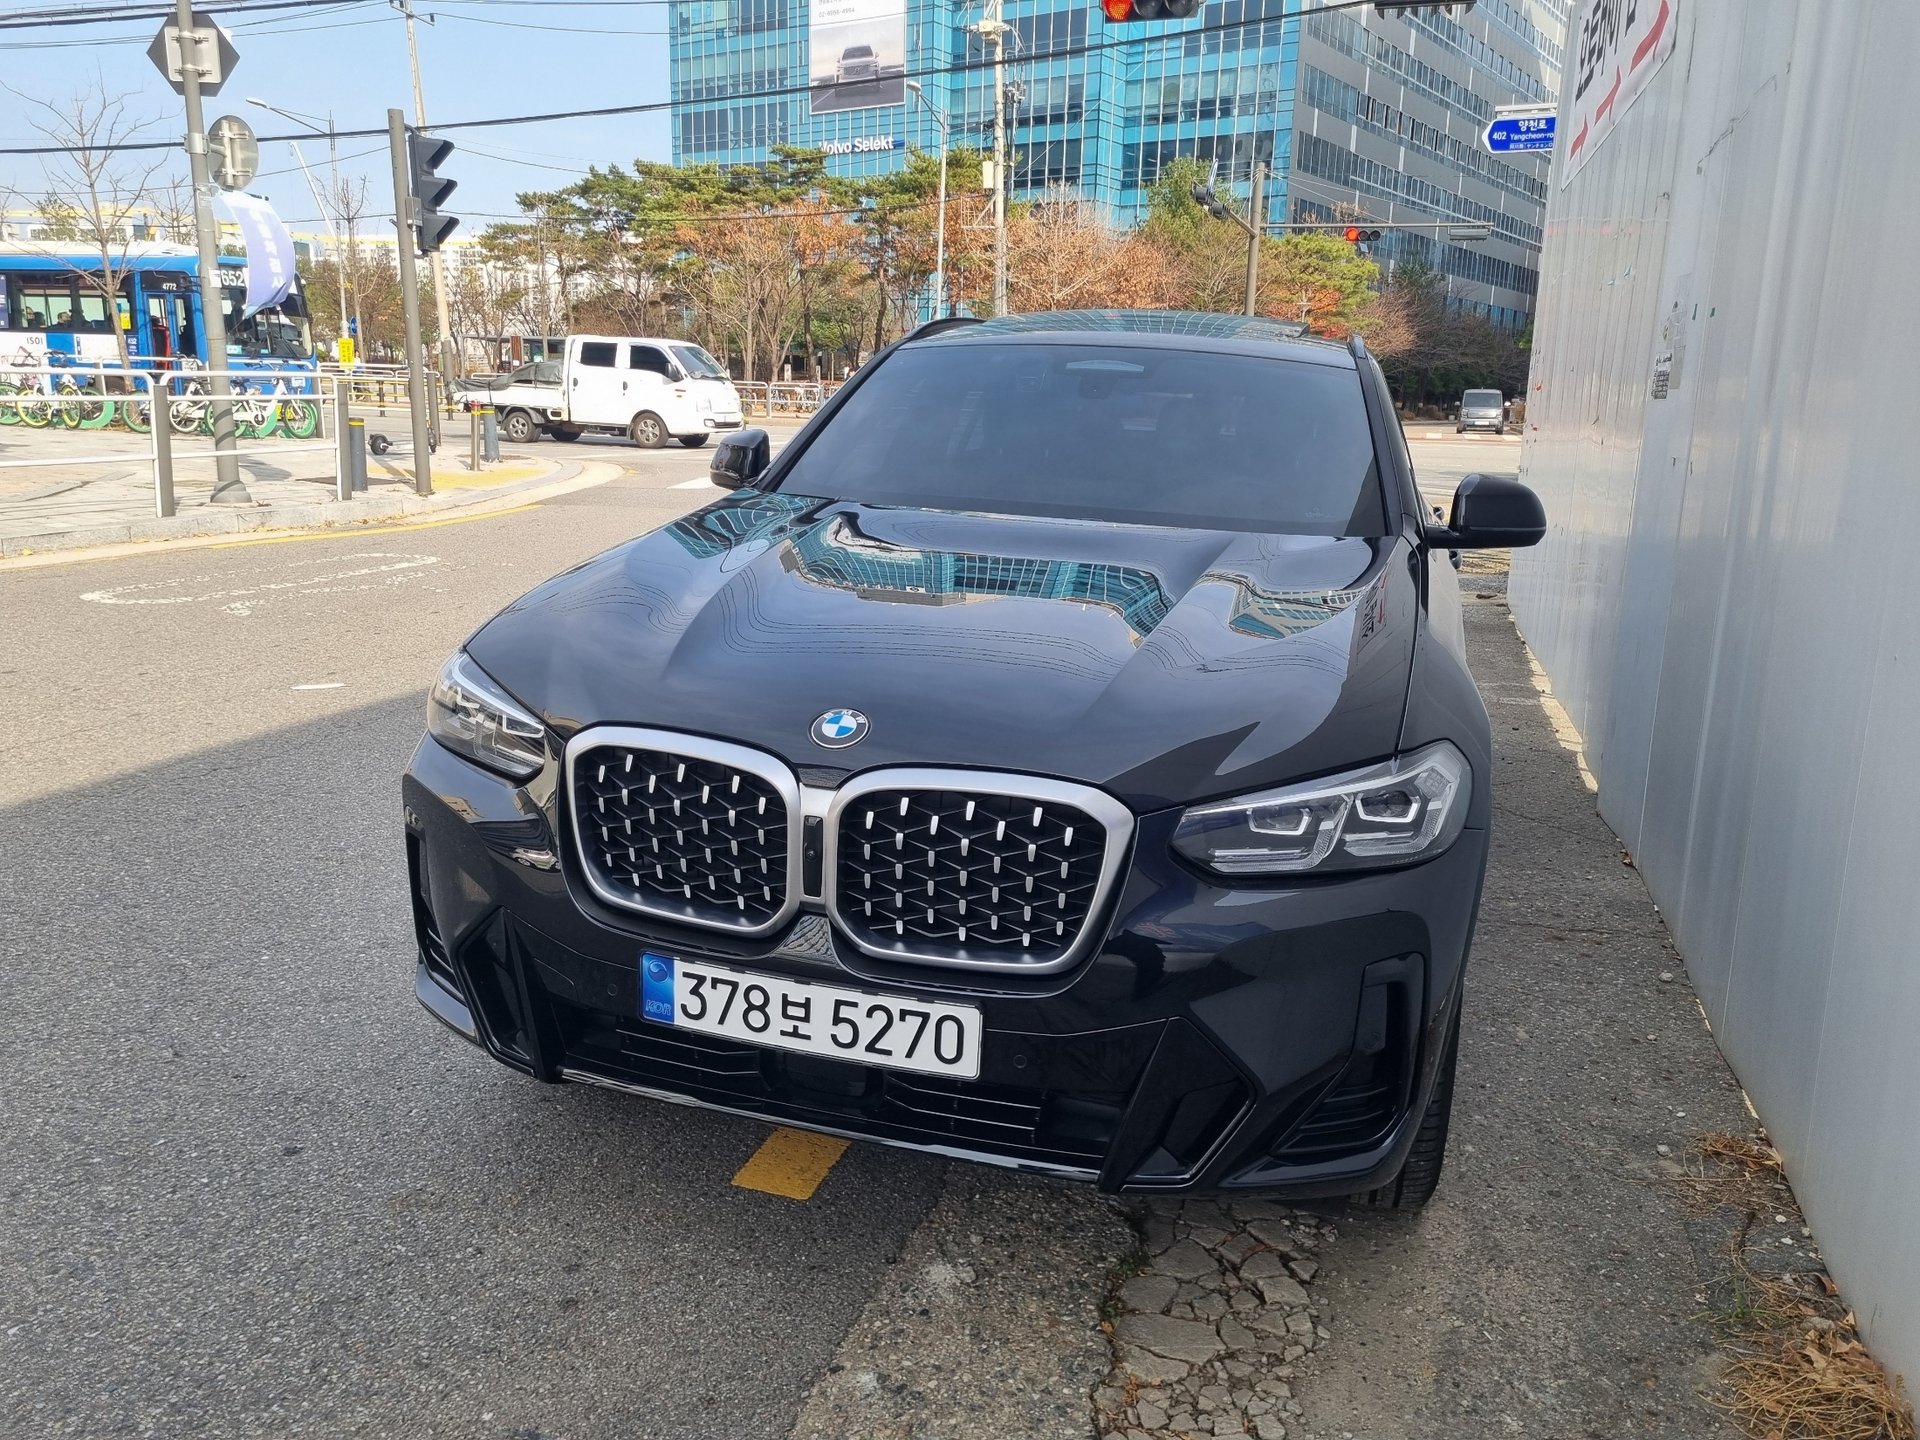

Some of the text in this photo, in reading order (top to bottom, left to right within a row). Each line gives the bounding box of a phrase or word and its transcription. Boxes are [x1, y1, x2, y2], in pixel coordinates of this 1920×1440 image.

[1518, 119, 1547, 131] 양천로
[854, 135, 894, 152] Selekt
[1492, 131, 1554, 141] 402 Yangcheon-ro
[823, 709, 866, 724] BMW
[645, 999, 672, 1016] KOR
[680, 971, 965, 1066] 378보 5270
